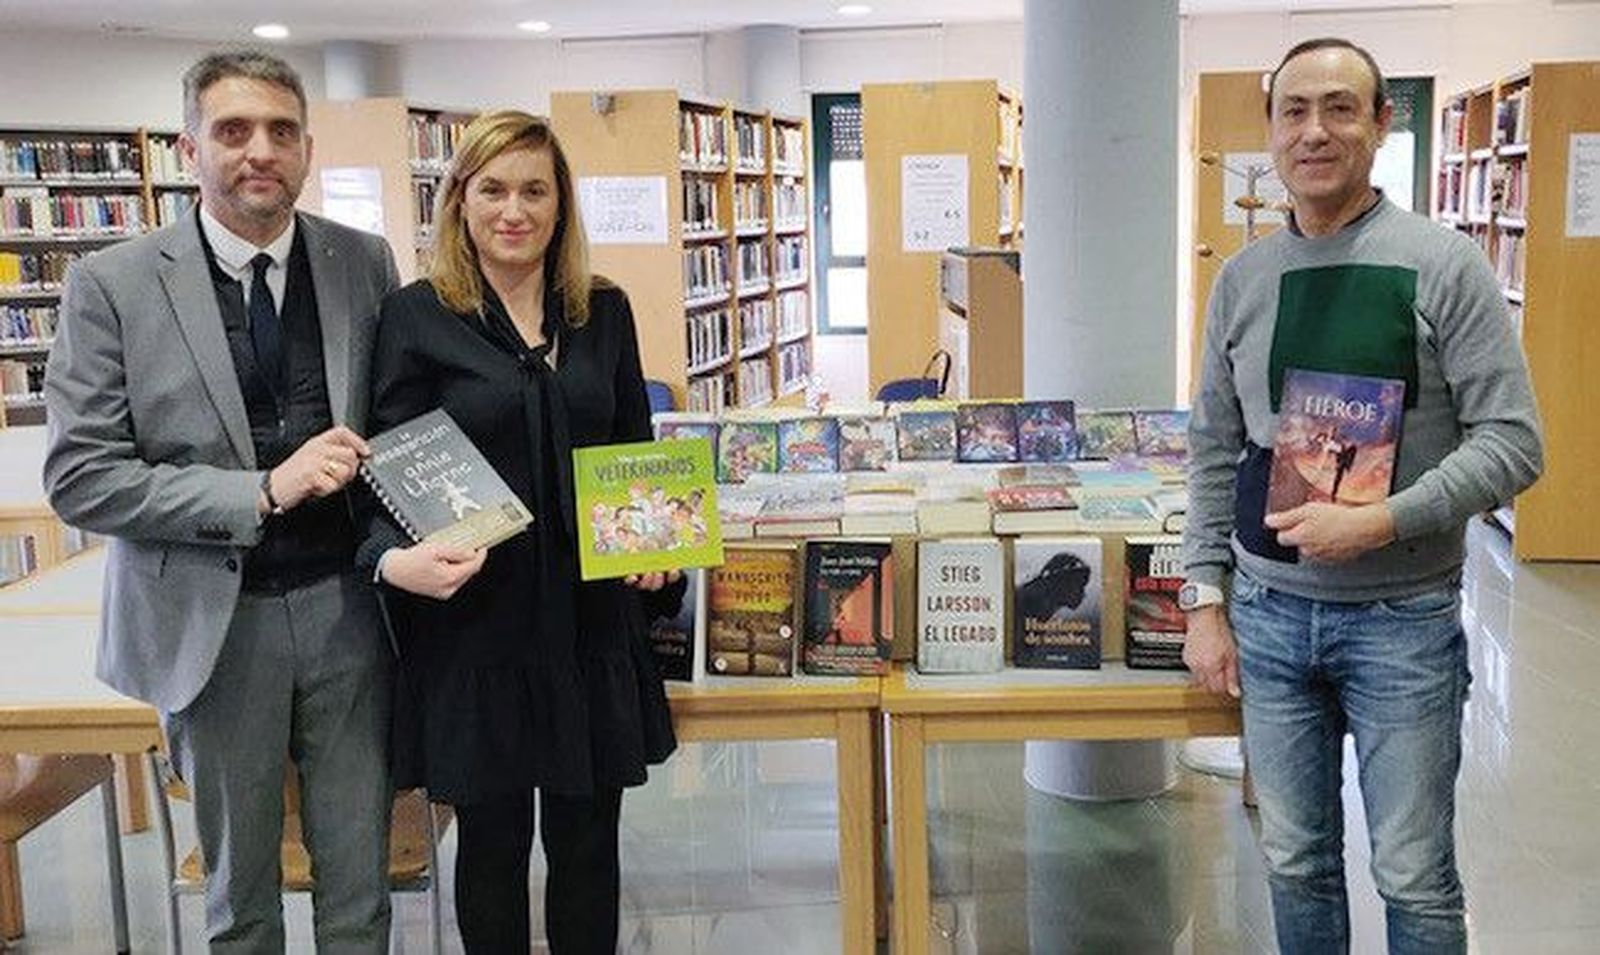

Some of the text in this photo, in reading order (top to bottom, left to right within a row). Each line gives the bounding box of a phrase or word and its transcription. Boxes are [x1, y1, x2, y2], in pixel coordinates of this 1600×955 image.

[594, 457, 696, 481] VETERINARIOS
[717, 570, 791, 585] MANUSCRITO
[940, 564, 982, 583] STIEG
[927, 595, 992, 613] LARSSON
[924, 624, 997, 645] EL LEGADO
